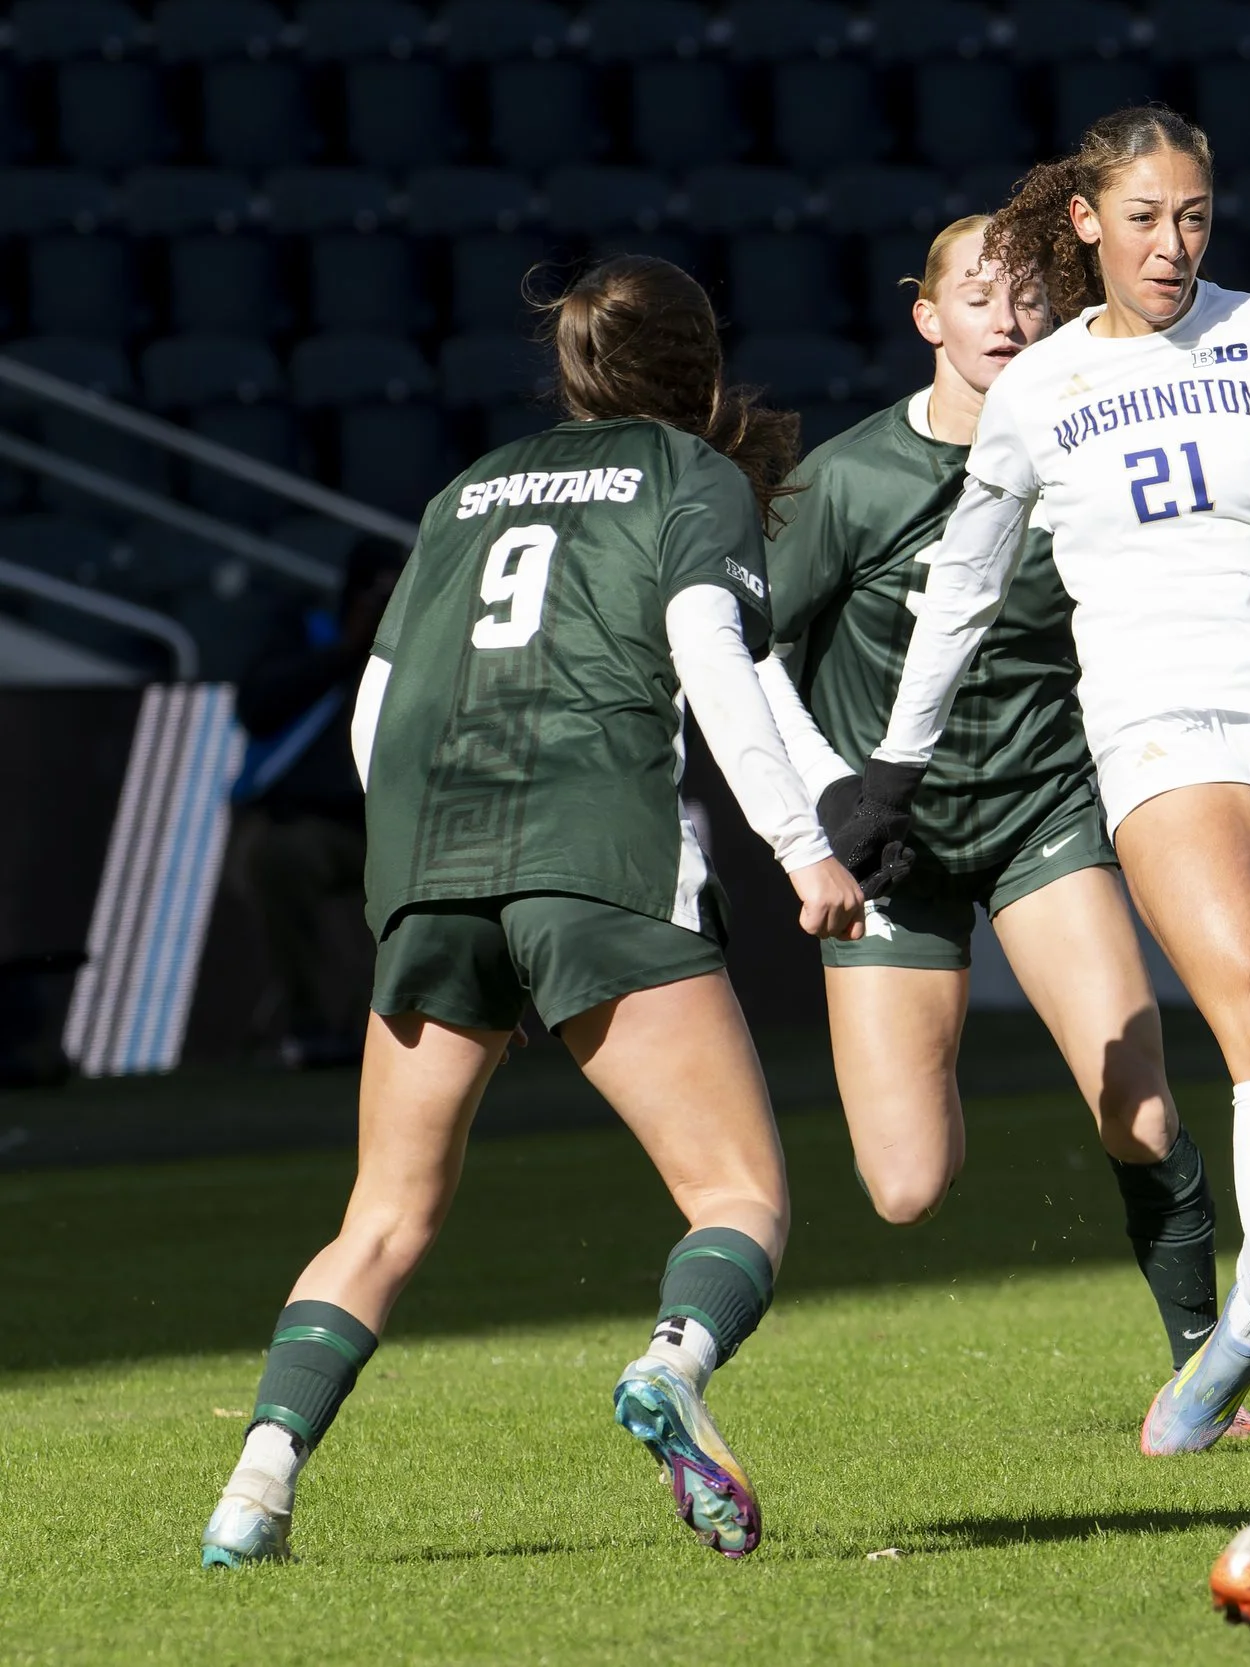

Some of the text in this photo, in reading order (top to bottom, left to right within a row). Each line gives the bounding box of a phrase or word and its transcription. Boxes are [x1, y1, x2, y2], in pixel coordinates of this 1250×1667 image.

[456, 467, 644, 520] SPARTANS
[1123, 441, 1217, 525] 21
[471, 524, 558, 649] 9
